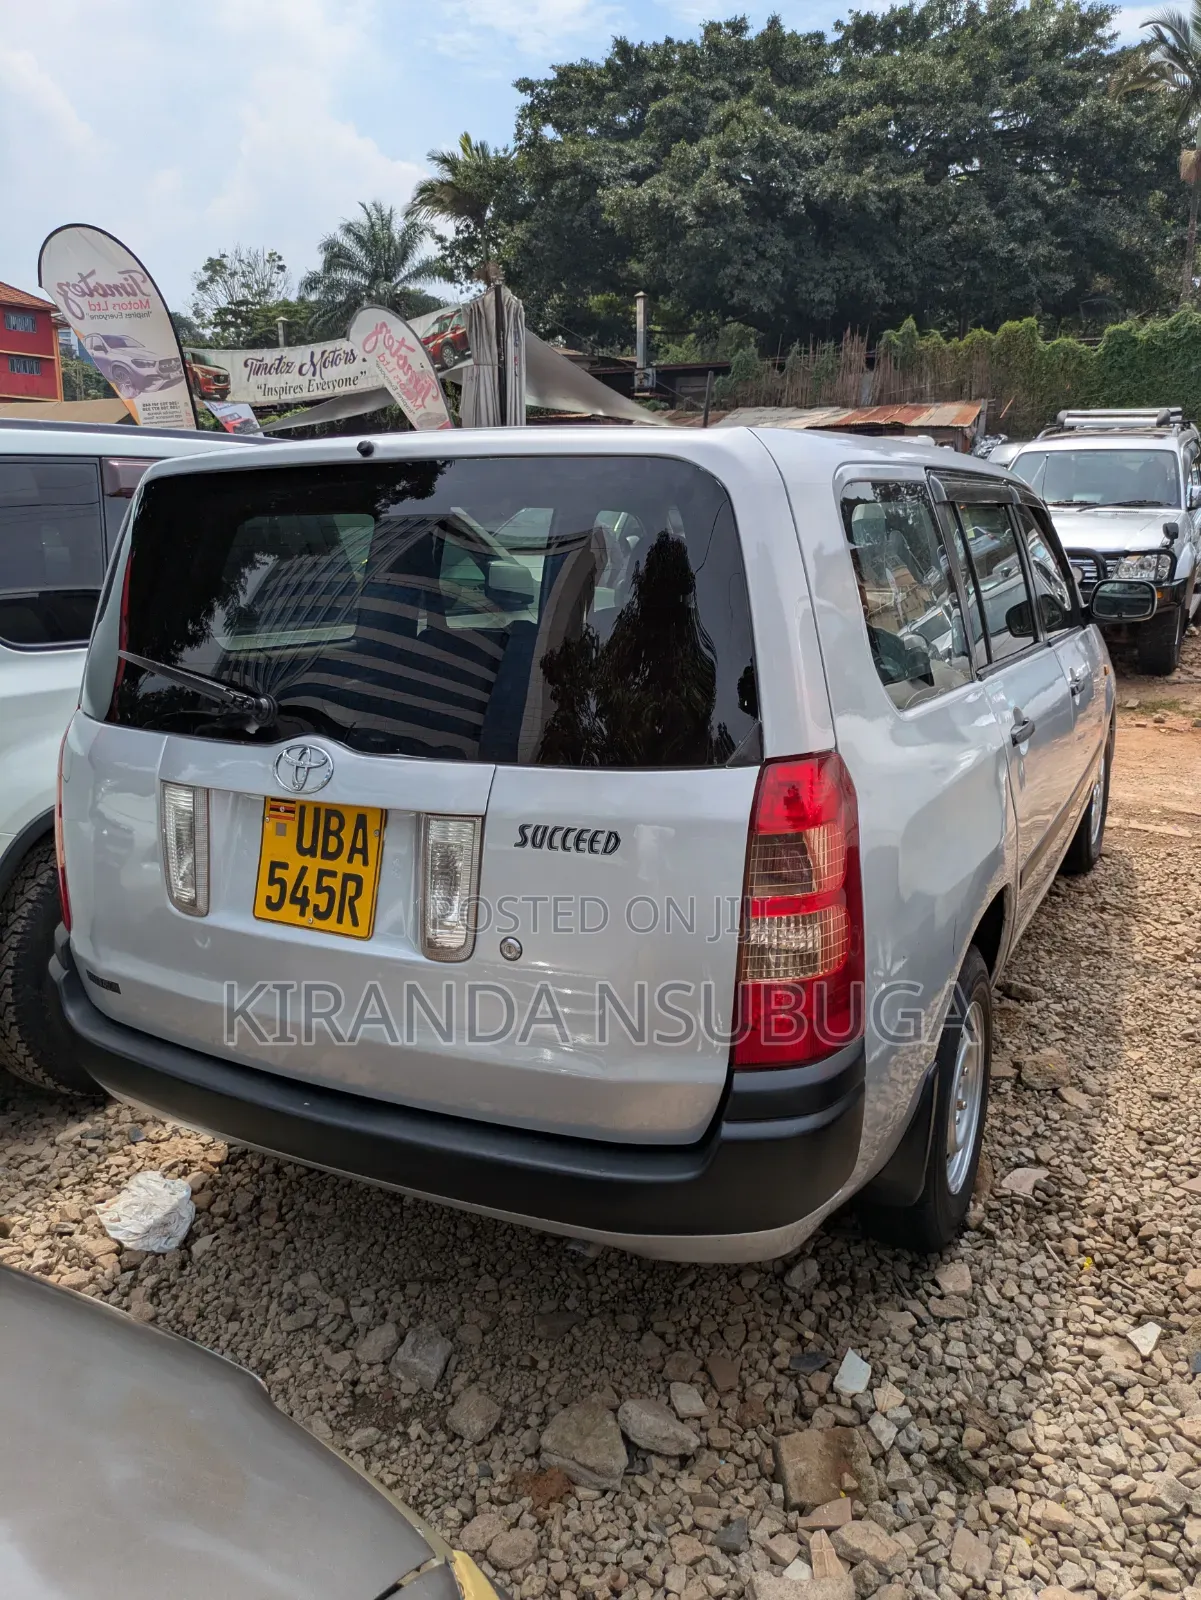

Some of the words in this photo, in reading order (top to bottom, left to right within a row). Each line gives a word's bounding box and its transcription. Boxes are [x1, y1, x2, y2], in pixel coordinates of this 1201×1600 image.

[296, 805, 369, 867] UBA
[514, 824, 621, 855] SUCCEED
[265, 860, 364, 927] 545R
